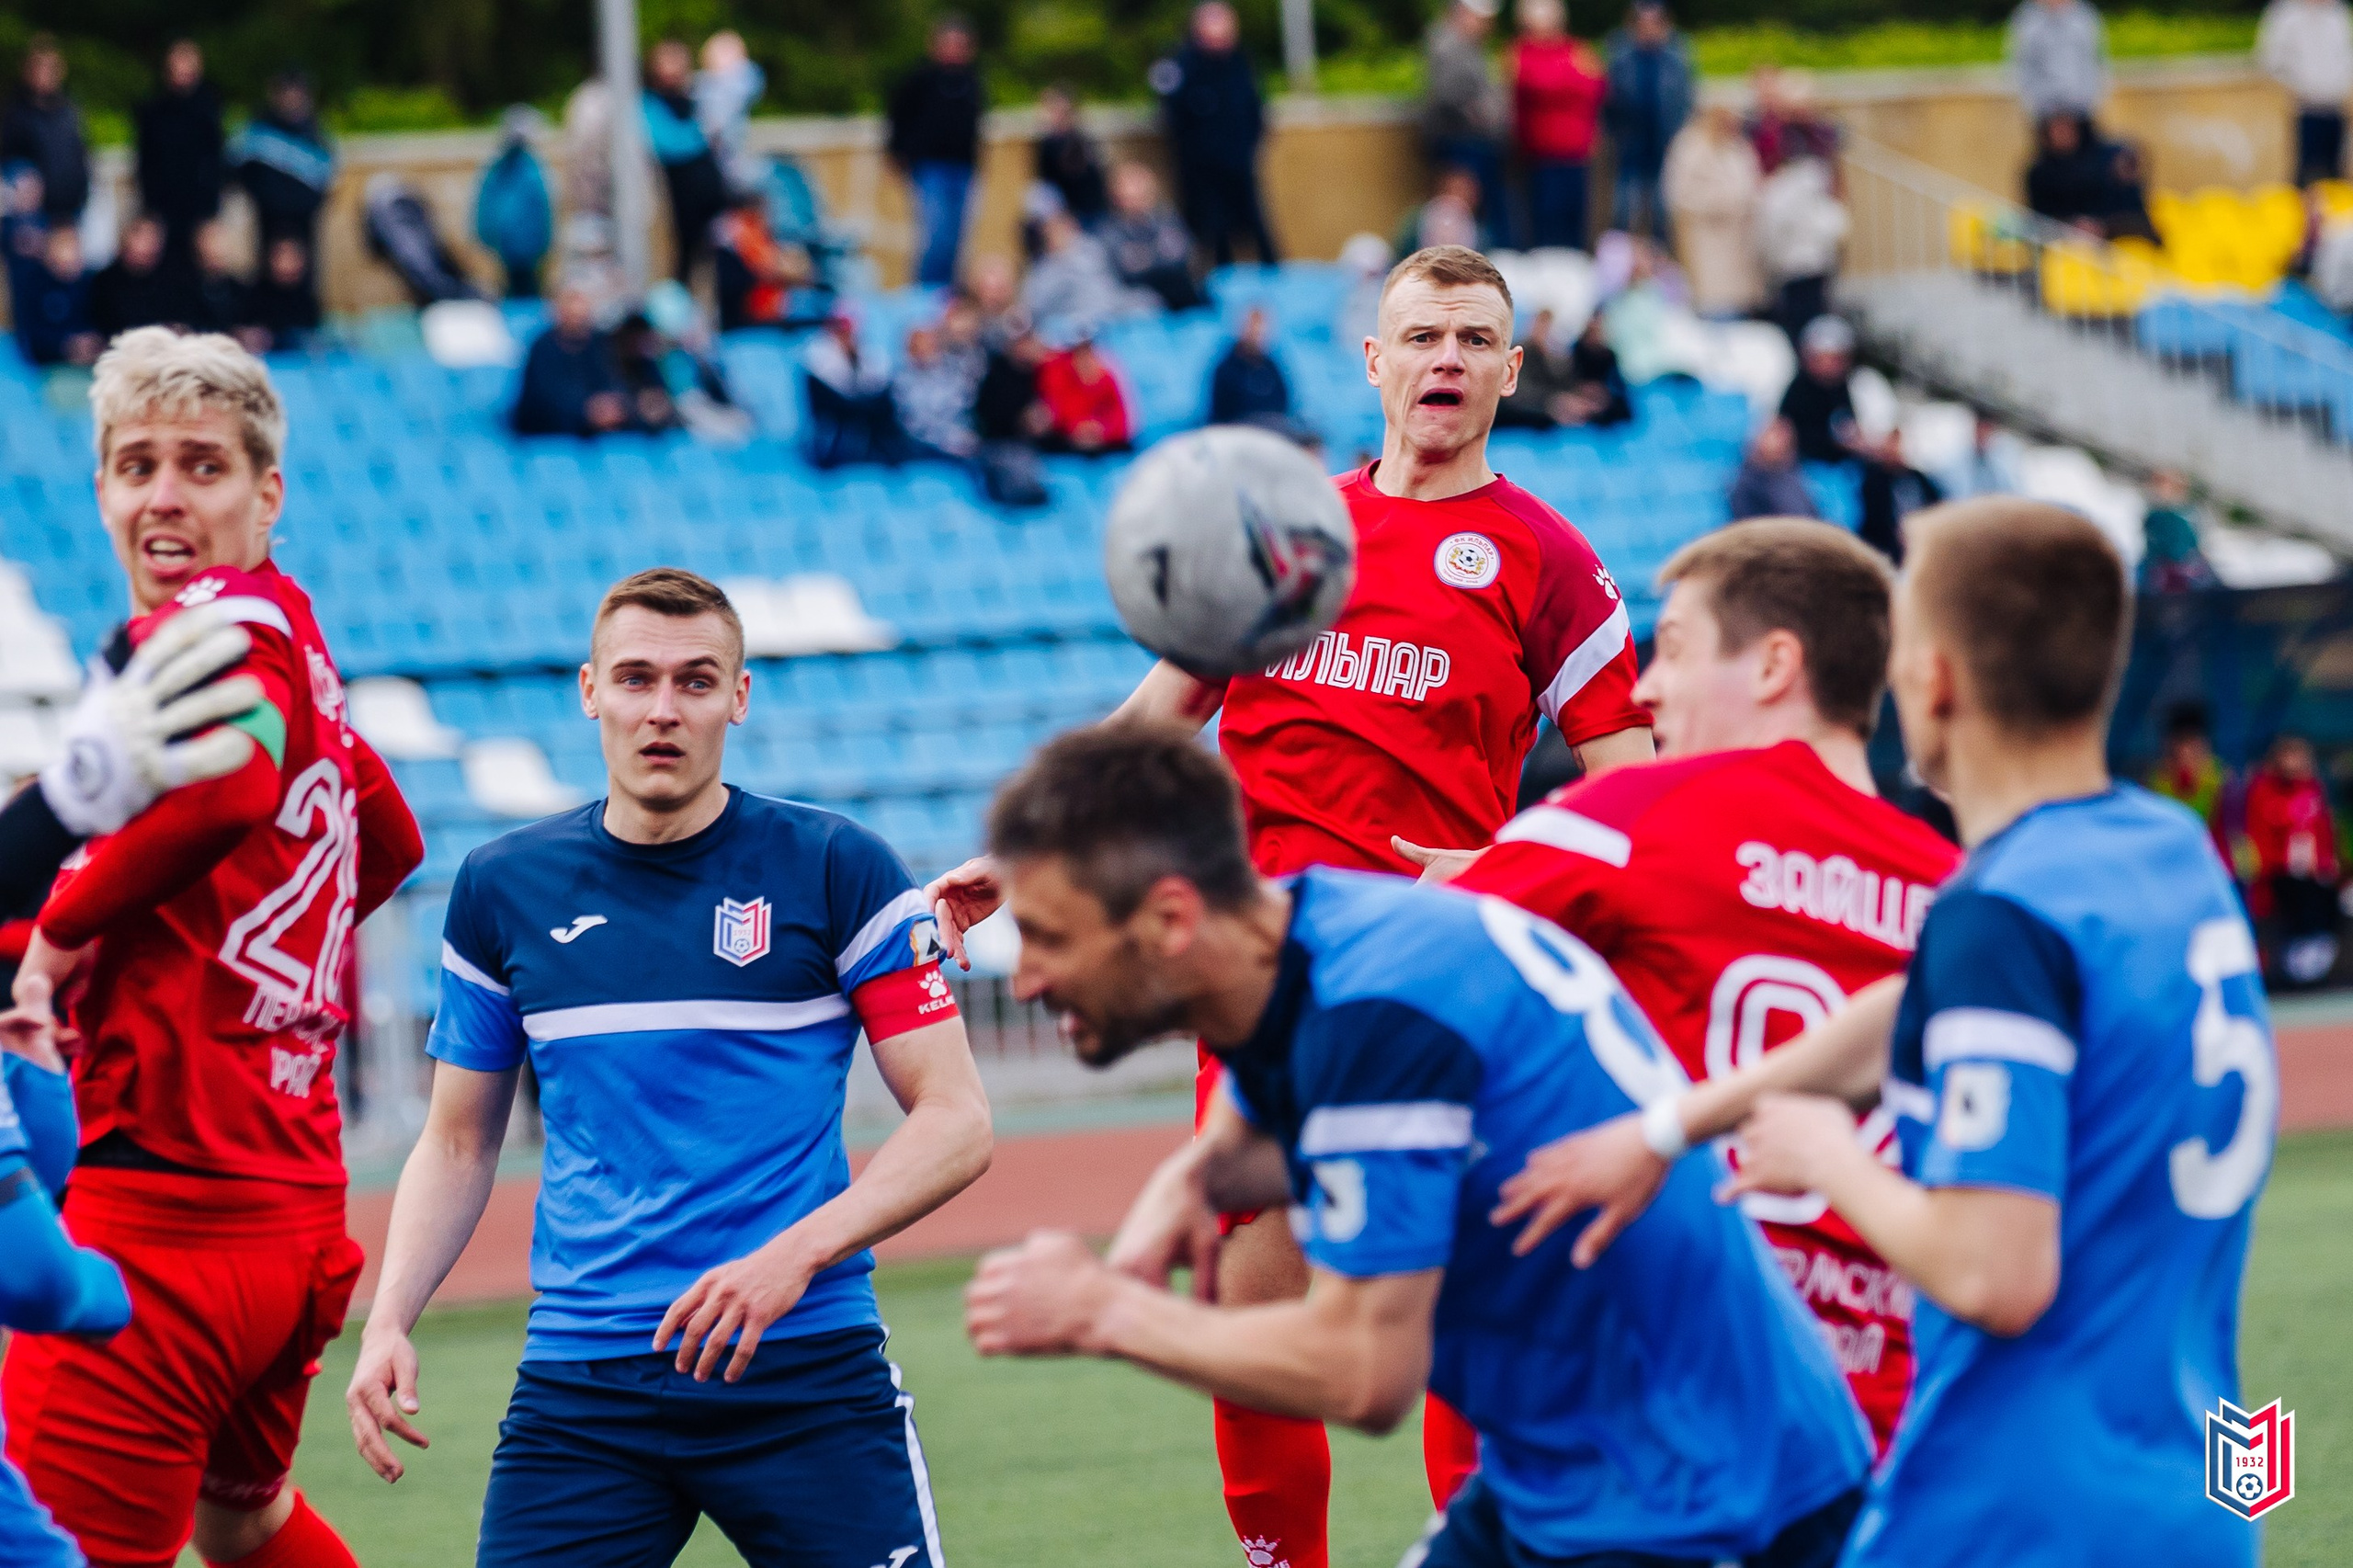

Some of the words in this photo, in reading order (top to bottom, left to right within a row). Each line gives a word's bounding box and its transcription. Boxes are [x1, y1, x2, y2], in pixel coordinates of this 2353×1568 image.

[1468, 537, 1495, 556] ИЛЬПАР
[1734, 840, 1938, 952] ЗАЙЦЕ
[917, 994, 956, 1016] KELM
[1476, 893, 1693, 1112] 8
[2166, 918, 2279, 1221] 5
